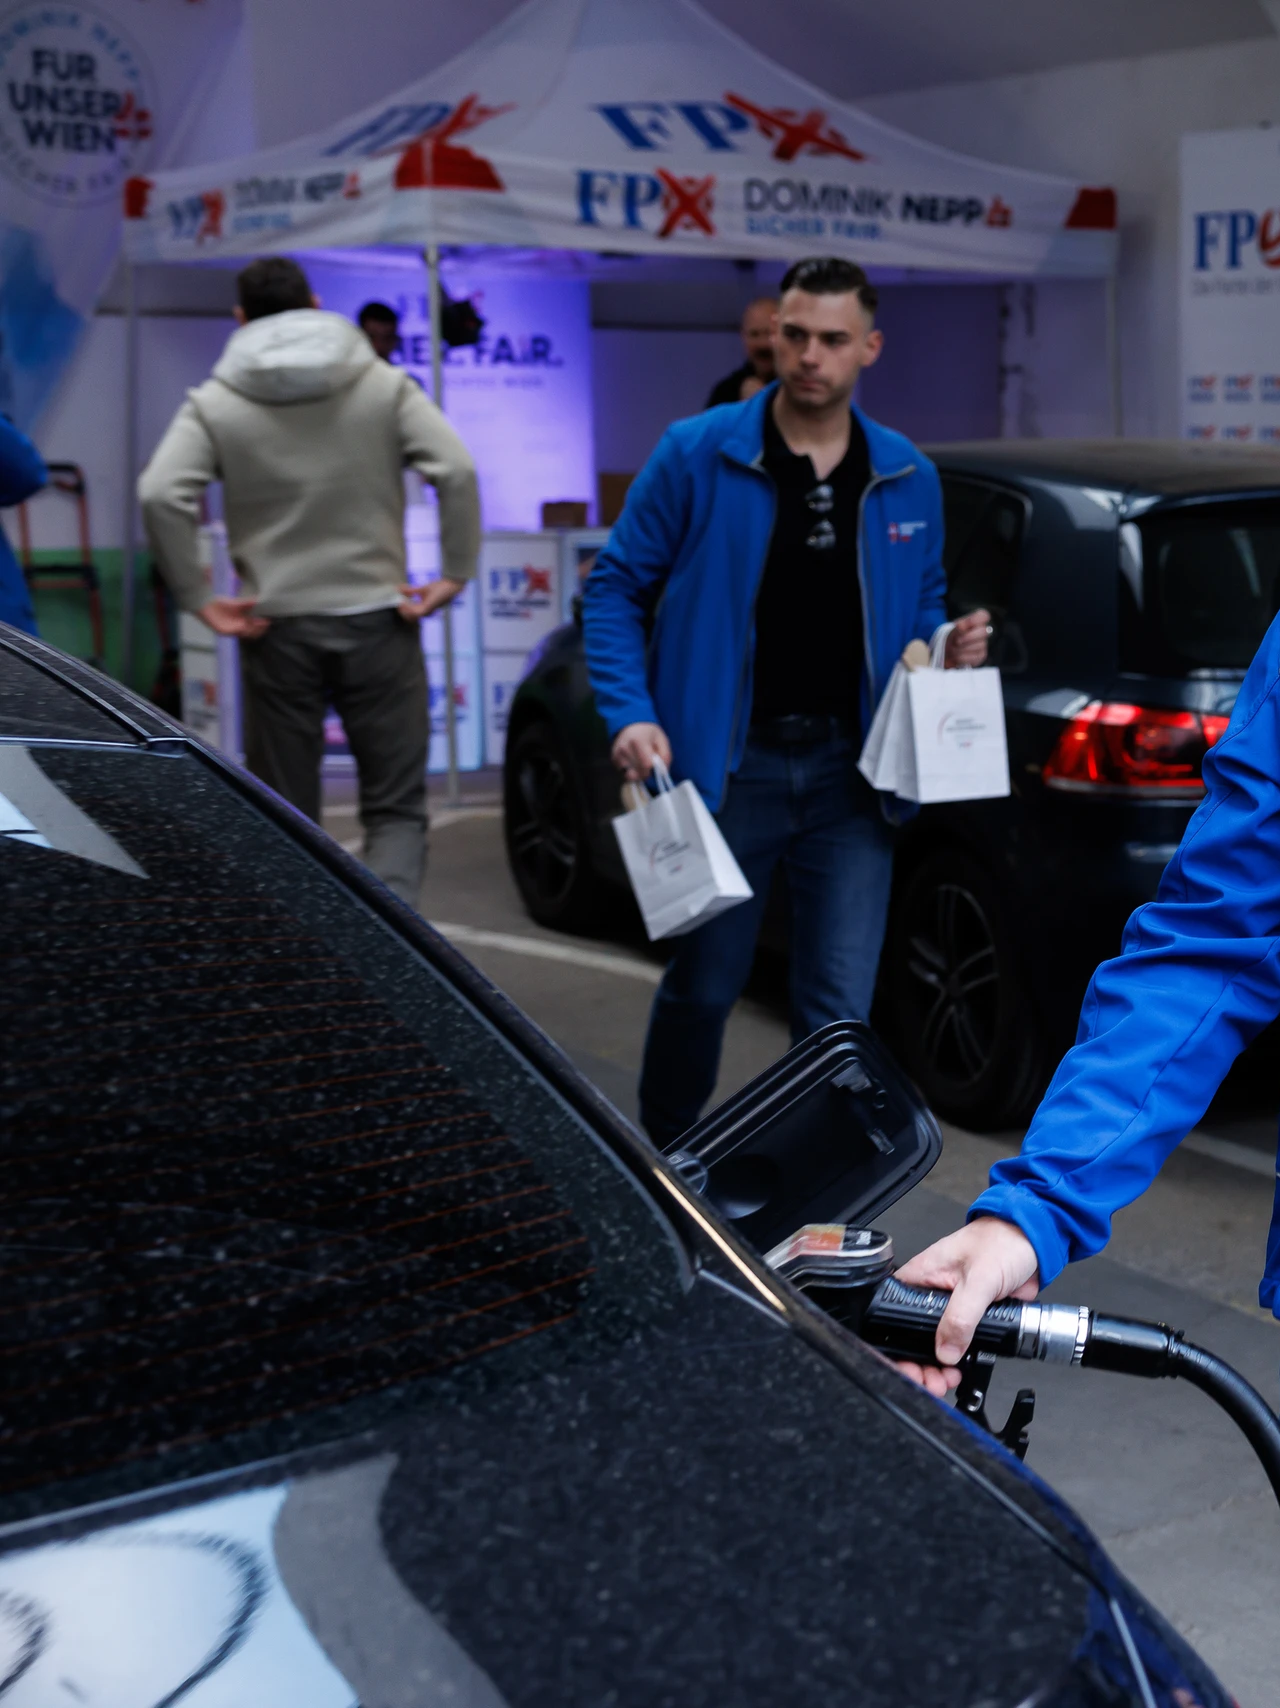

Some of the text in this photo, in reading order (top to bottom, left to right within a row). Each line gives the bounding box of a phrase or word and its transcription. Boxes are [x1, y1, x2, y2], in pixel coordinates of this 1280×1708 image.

[8, 82, 122, 119] UNSER
[22, 118, 117, 152] WIEN
[743, 178, 894, 221] DOMINIK
[902, 192, 985, 227] NEPP
